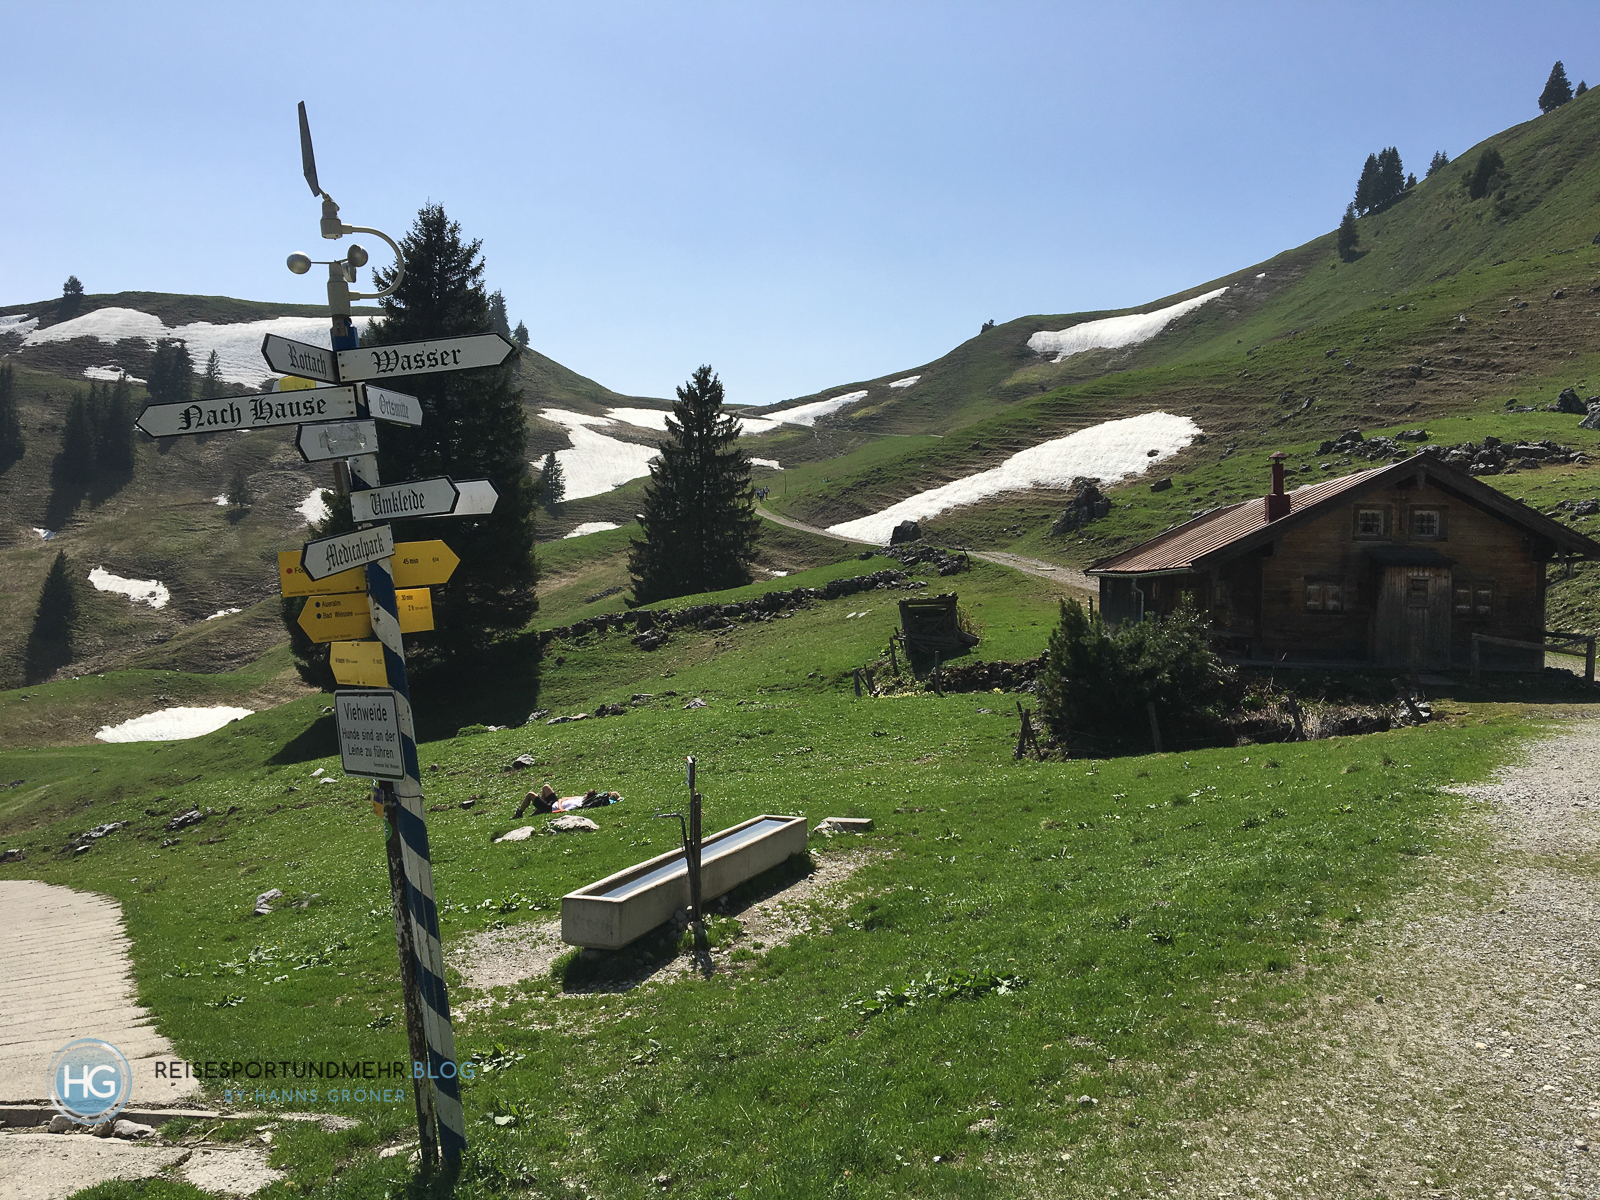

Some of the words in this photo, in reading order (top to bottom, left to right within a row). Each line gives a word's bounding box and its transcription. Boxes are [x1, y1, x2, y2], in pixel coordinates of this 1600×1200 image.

[287, 343, 327, 376] Rottach
[371, 347, 463, 375] Wasser
[178, 403, 243, 431] Nach
[249, 396, 328, 423] Hause
[370, 488, 427, 516] Umkleide
[325, 532, 386, 573] Medicalpark
[322, 611, 333, 619] Bad
[343, 702, 388, 722] Viehweide
[341, 727, 360, 741] Hunde
[362, 728, 374, 741] sind
[375, 732, 384, 742] an
[384, 729, 396, 743] der
[347, 743, 364, 757] Leine
[365, 747, 373, 757] zu
